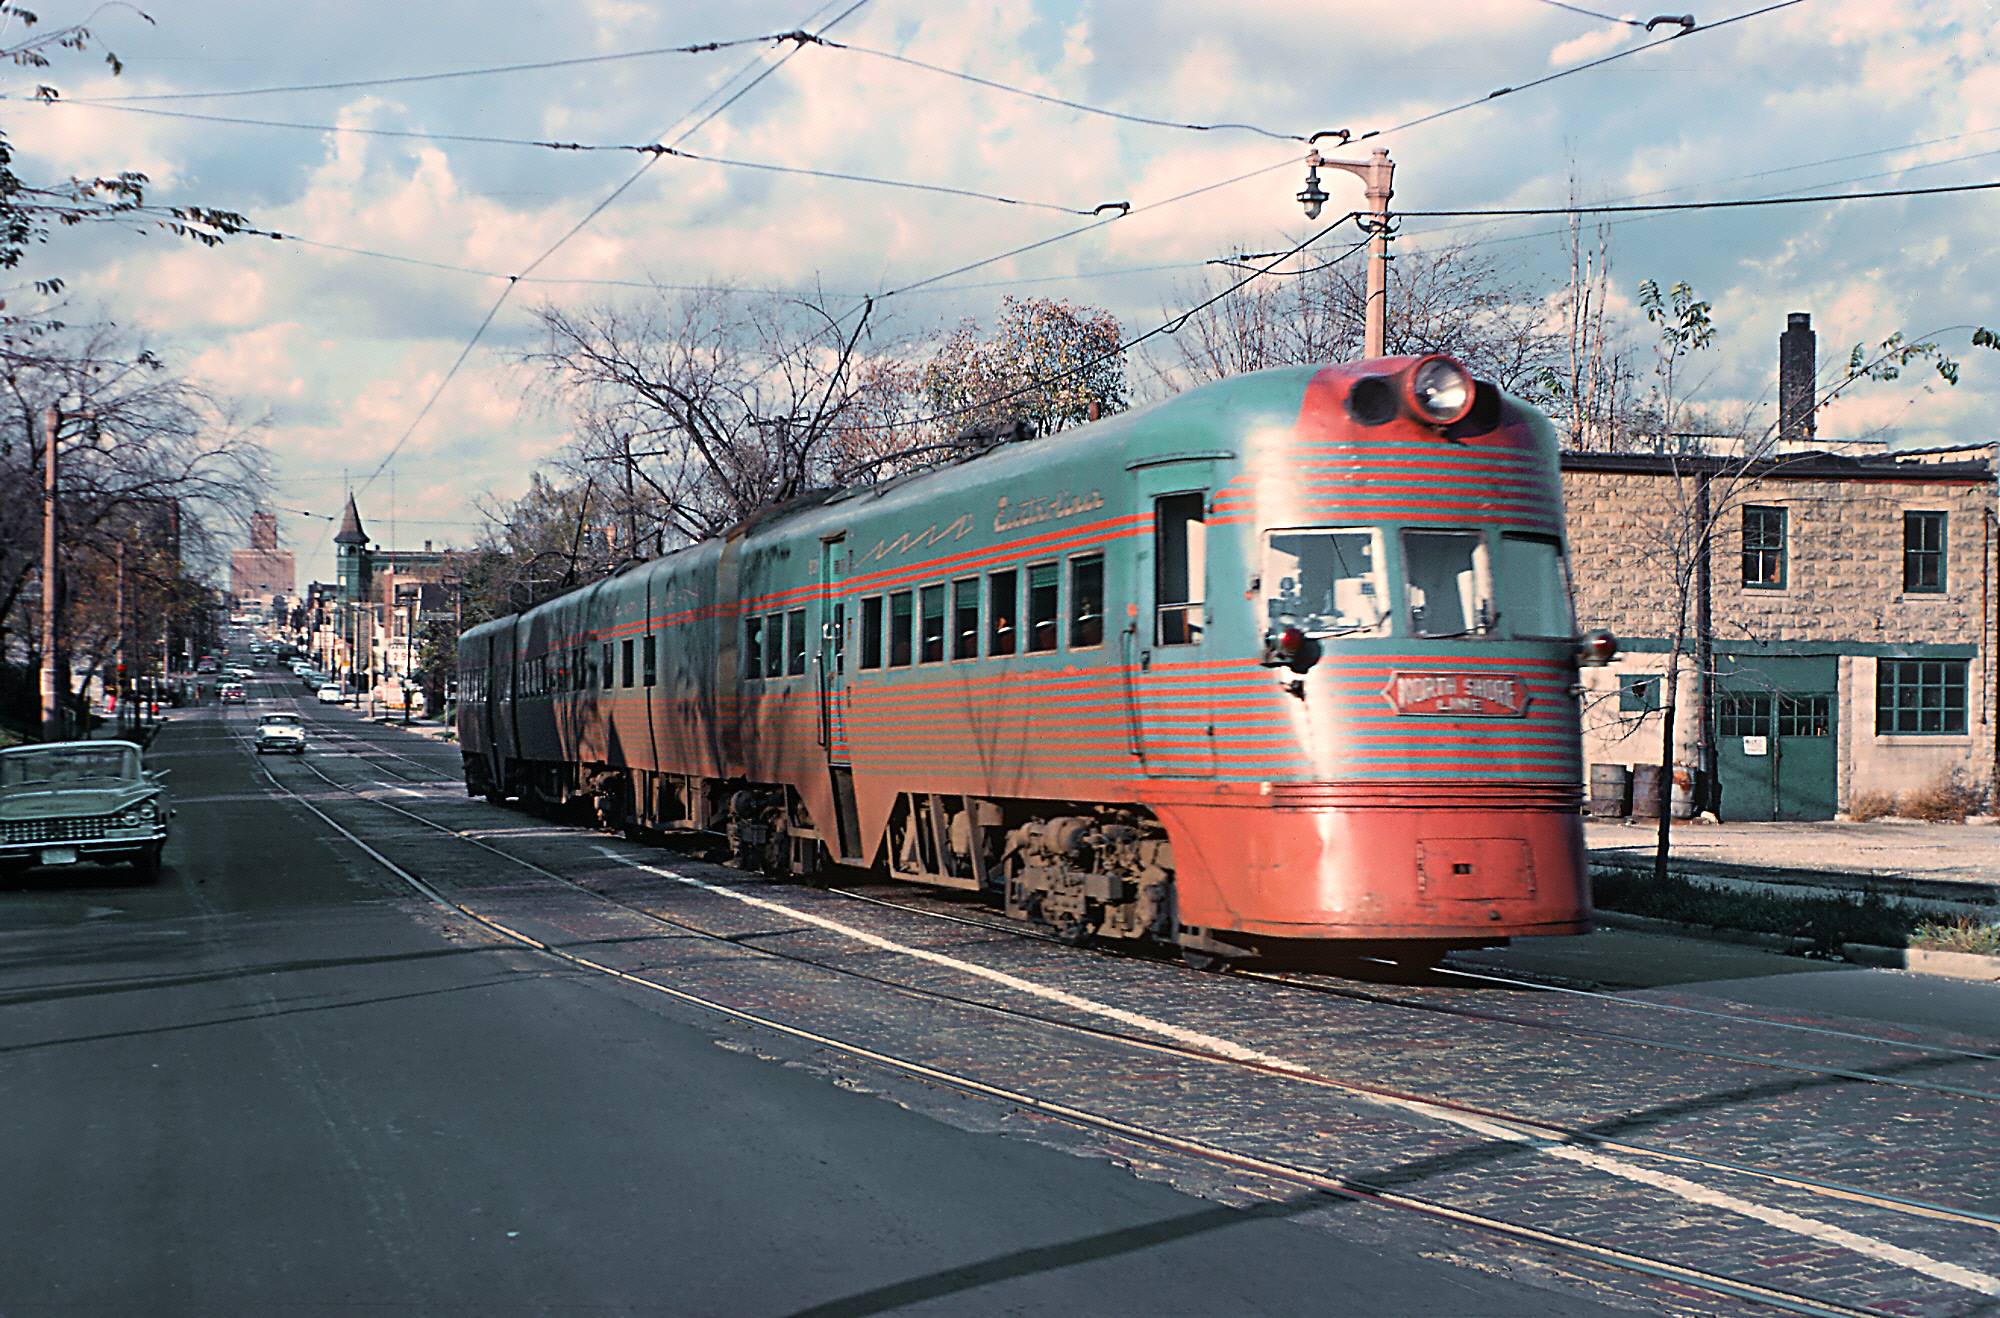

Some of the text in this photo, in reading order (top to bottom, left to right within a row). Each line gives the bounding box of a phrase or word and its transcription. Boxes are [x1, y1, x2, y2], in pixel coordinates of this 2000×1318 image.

[1397, 677, 1518, 711] NORTH SHORE
[1436, 697, 1483, 711] LINE
